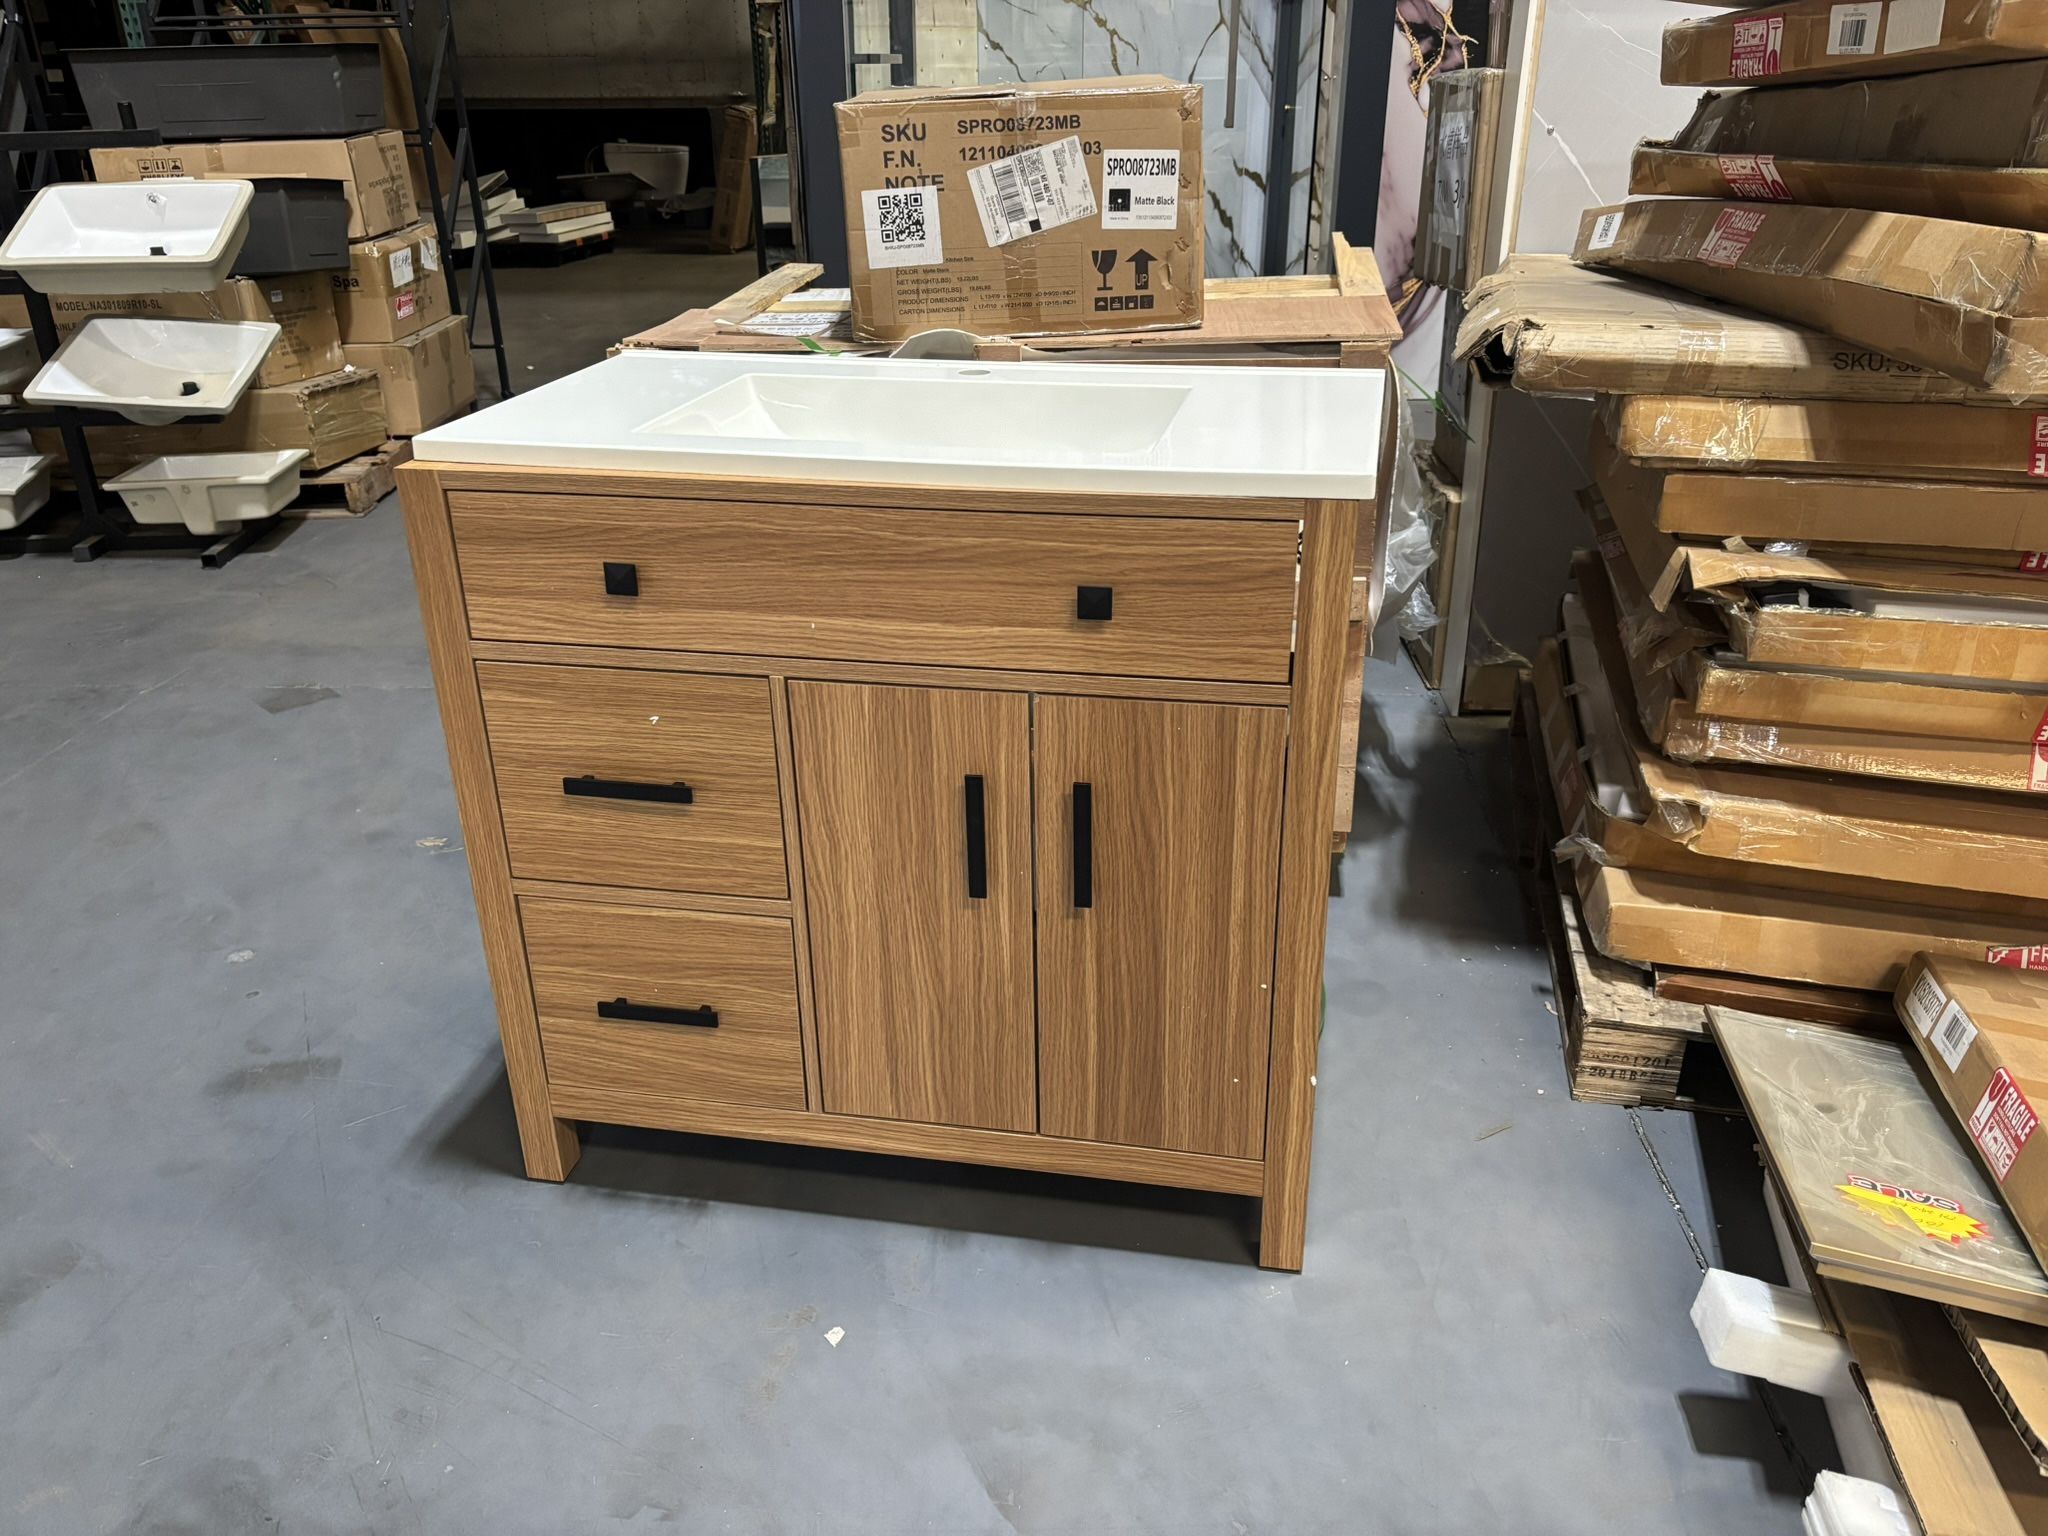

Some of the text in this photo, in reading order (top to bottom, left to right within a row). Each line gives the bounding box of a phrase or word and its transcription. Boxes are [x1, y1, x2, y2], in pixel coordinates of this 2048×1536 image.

[1729, 57, 1764, 79] FRAGILE
[881, 114, 1081, 142] SKU SPRO08723MB
[883, 150, 921, 168] F.N.
[1107, 158, 1176, 176] SPRO08723MB
[885, 174, 945, 192] NOTE
[1729, 183, 1776, 199] FRAGILE
[1134, 196, 1175, 206] Matte Black
[1727, 209, 1767, 232] FRAGILE
[332, 275, 360, 290] Spa
[1136, 273, 1148, 286] UP
[930, 296, 969, 304] DIMENSIONS
[1833, 352, 1891, 373] SKU:
[2000, 1086, 2037, 1143] FRAGILE
[1848, 1175, 1960, 1213] SALE
